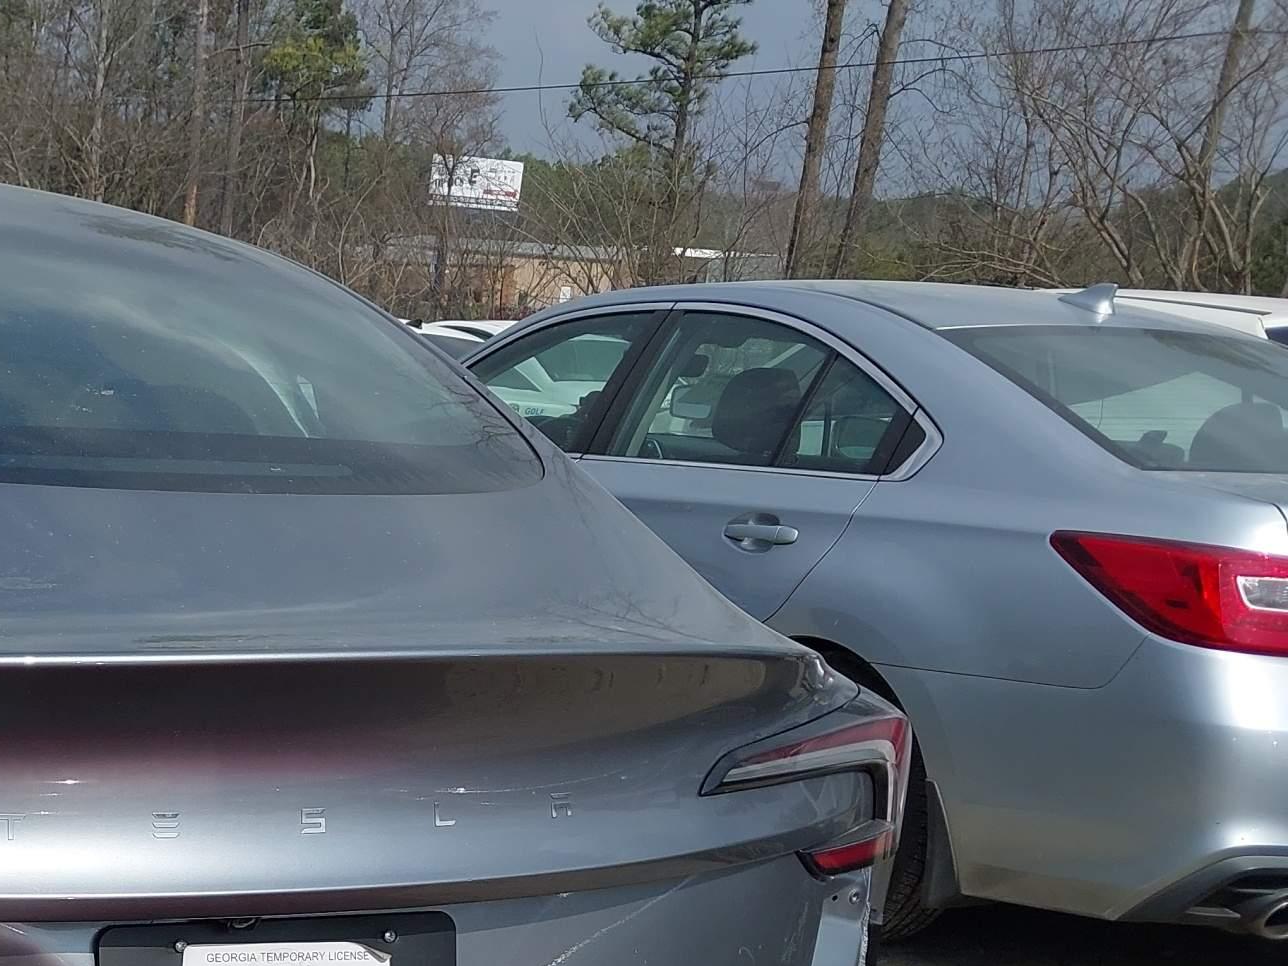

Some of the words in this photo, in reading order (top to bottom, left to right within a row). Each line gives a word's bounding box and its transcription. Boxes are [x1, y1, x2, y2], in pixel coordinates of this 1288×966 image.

[524, 407, 545, 416] GOLF
[206, 952, 257, 963] GEORGIA
[260, 951, 326, 962] TEMPORARY
[328, 950, 370, 961] LICENSE
